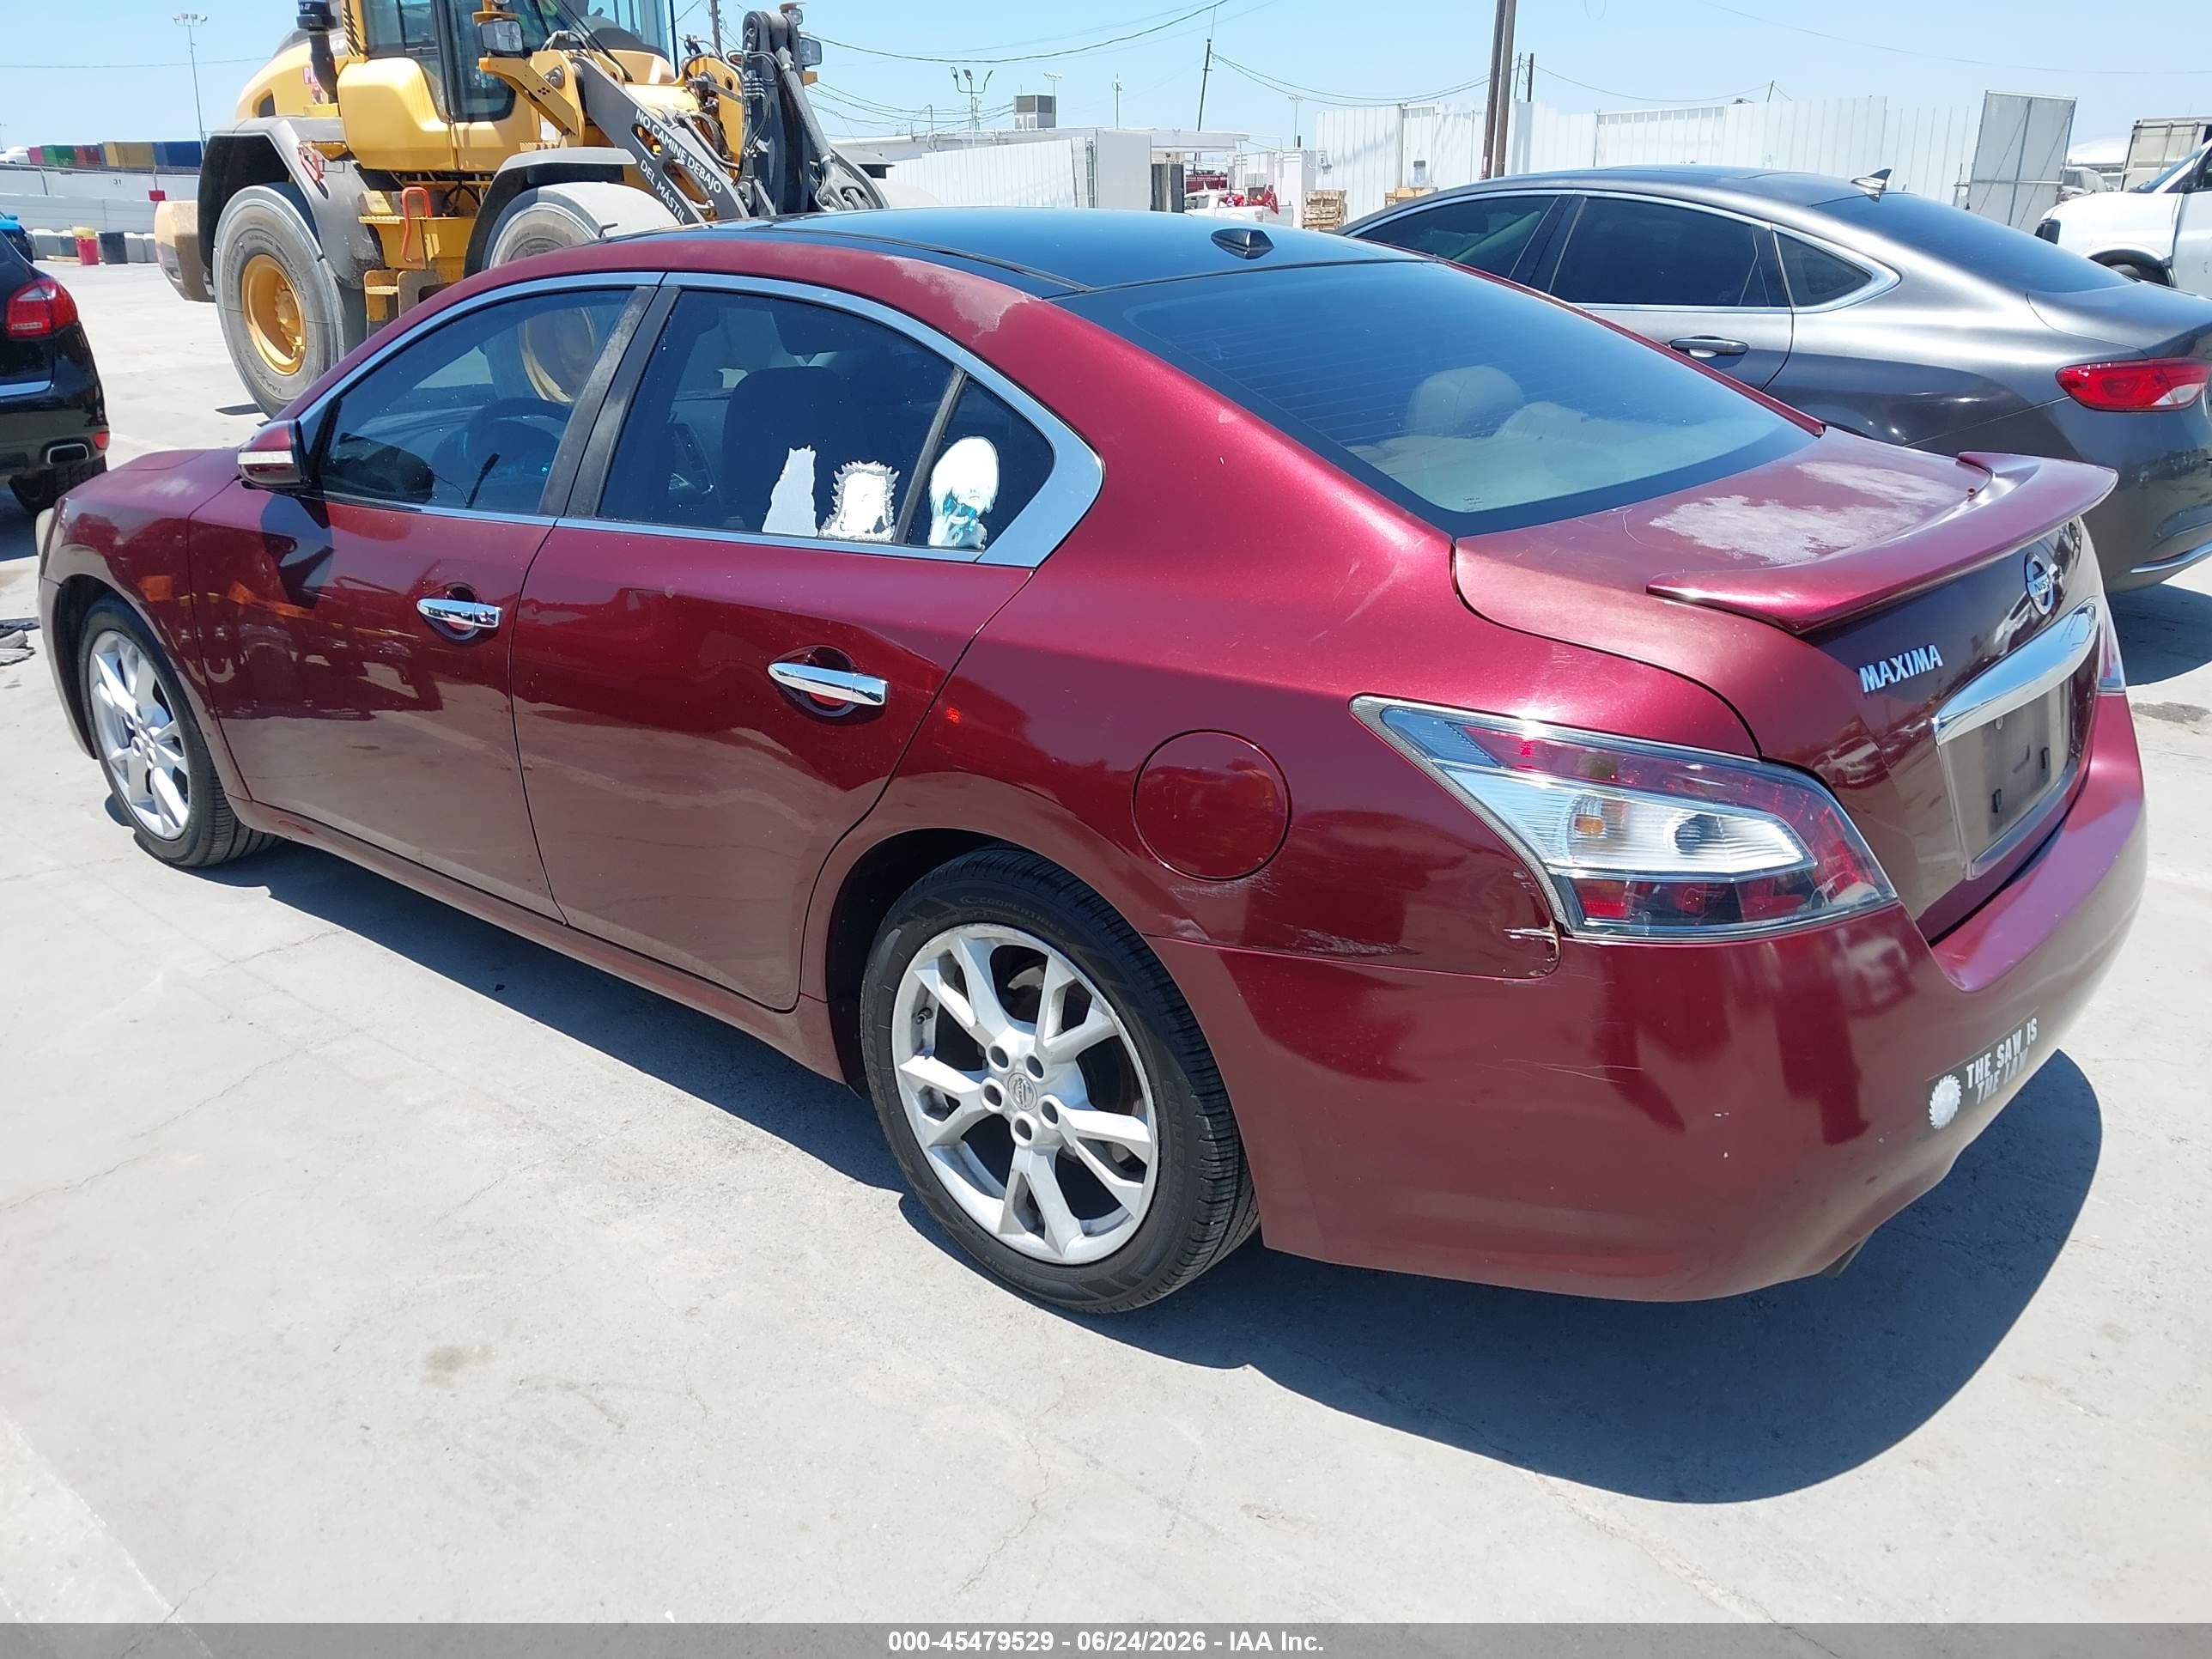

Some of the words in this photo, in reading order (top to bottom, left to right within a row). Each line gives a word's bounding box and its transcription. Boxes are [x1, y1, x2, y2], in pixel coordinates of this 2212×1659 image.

[635, 108, 651, 128] NO
[652, 125, 687, 162] CAMINE
[687, 155, 722, 193] DEBAJO
[640, 159, 655, 186] DEL
[656, 180, 685, 225] MÁSTIL
[1858, 644, 1943, 694] MAXIMA
[1966, 1053, 1992, 1089] THE
[1996, 1029, 2023, 1069] SAW
[2027, 1018, 2037, 1045] IS
[1976, 1070, 2001, 1105] THE
